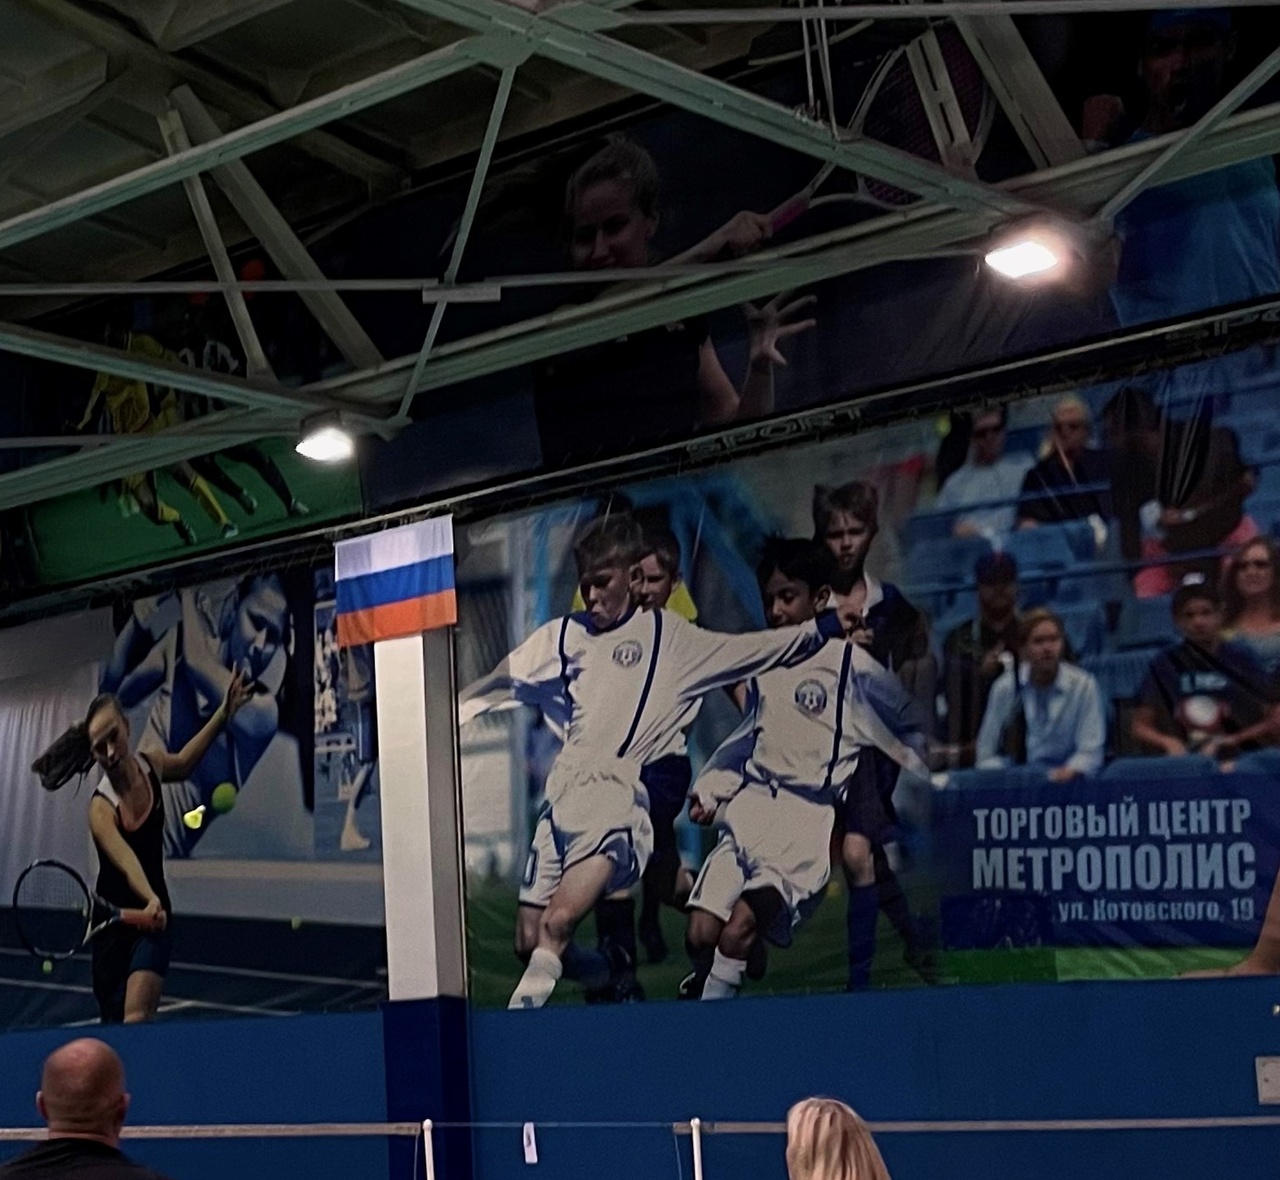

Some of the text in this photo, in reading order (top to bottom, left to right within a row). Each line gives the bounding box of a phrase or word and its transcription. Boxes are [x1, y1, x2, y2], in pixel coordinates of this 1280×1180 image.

[973, 796, 1251, 840] ТОРГОВЫЙ ЦЕНТР
[973, 842, 1256, 891] МЕТРОПОЛИС
[1058, 902, 1089, 922] ул.
[1231, 897, 1255, 921] 19
